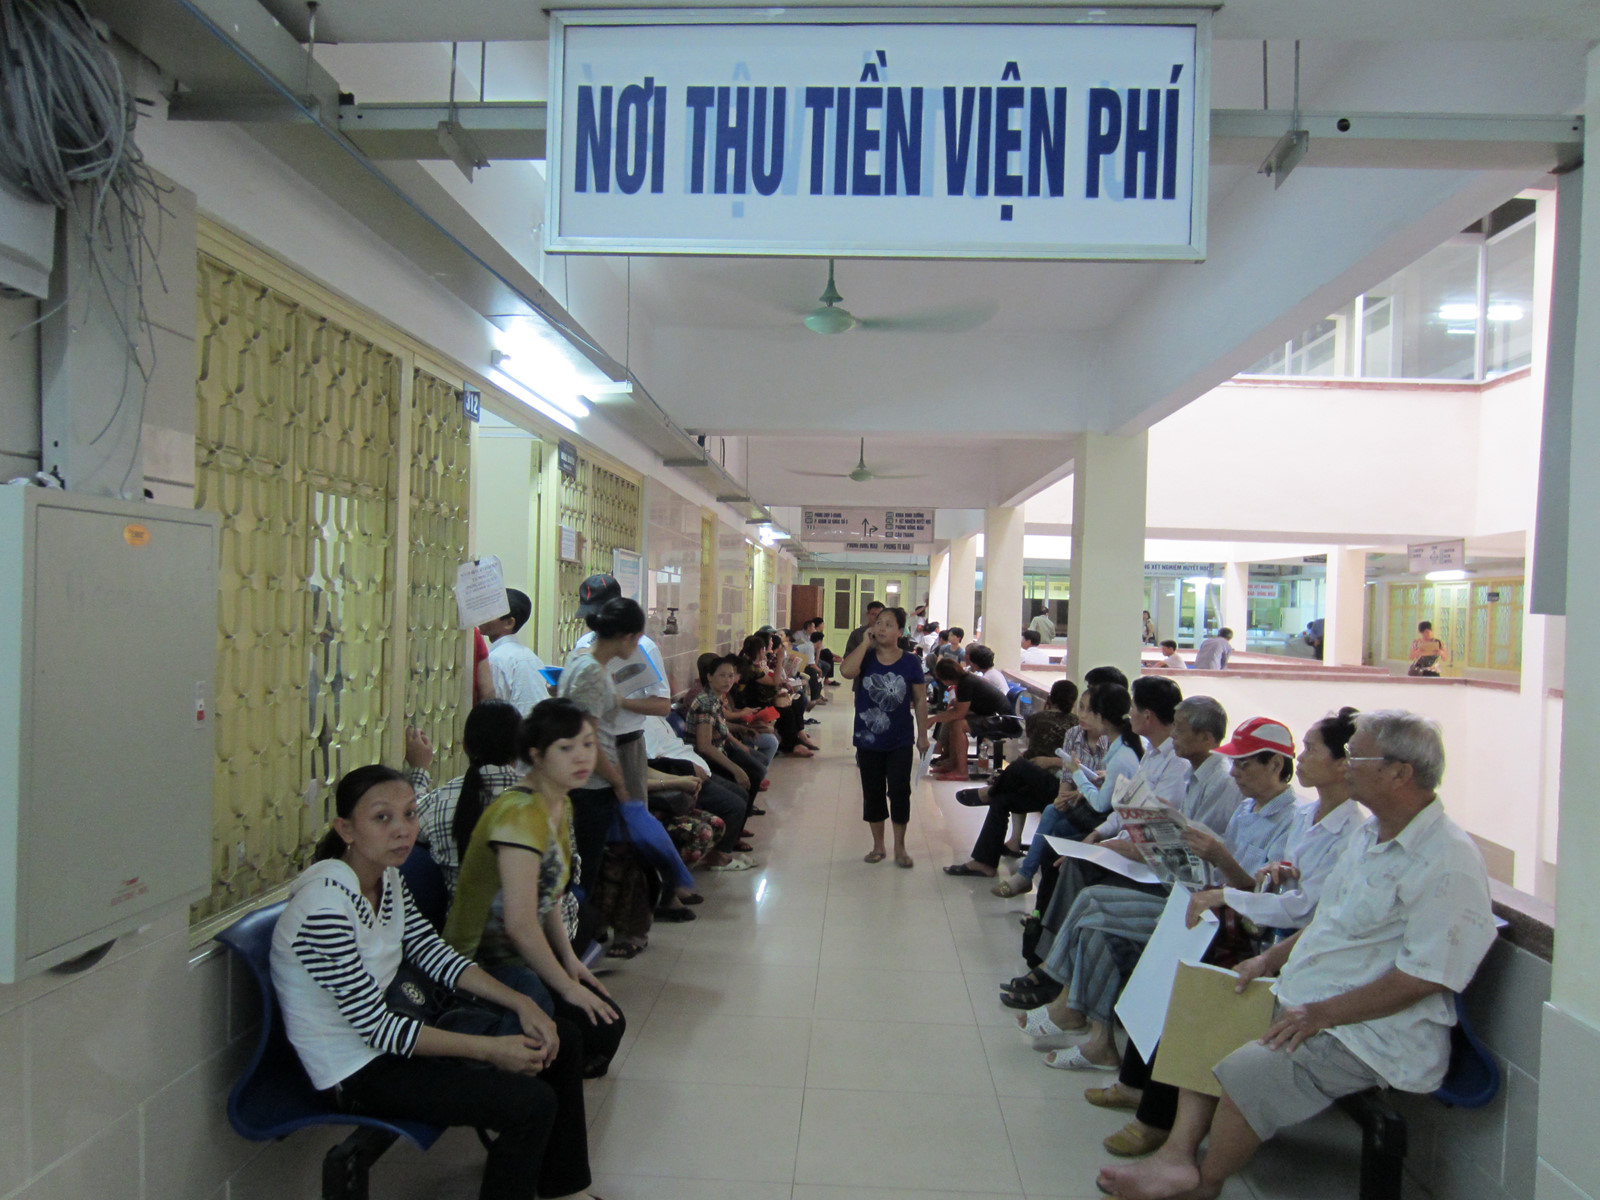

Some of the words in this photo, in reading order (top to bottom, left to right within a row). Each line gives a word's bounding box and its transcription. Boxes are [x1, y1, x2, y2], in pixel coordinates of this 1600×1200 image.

[575, 77, 666, 194] NƠI
[686, 85, 786, 196] THU
[805, 50, 924, 197] TIỀN
[943, 61, 1067, 221] VIỆN
[1085, 64, 1184, 200] PHÍ
[466, 392, 479, 414] 312
